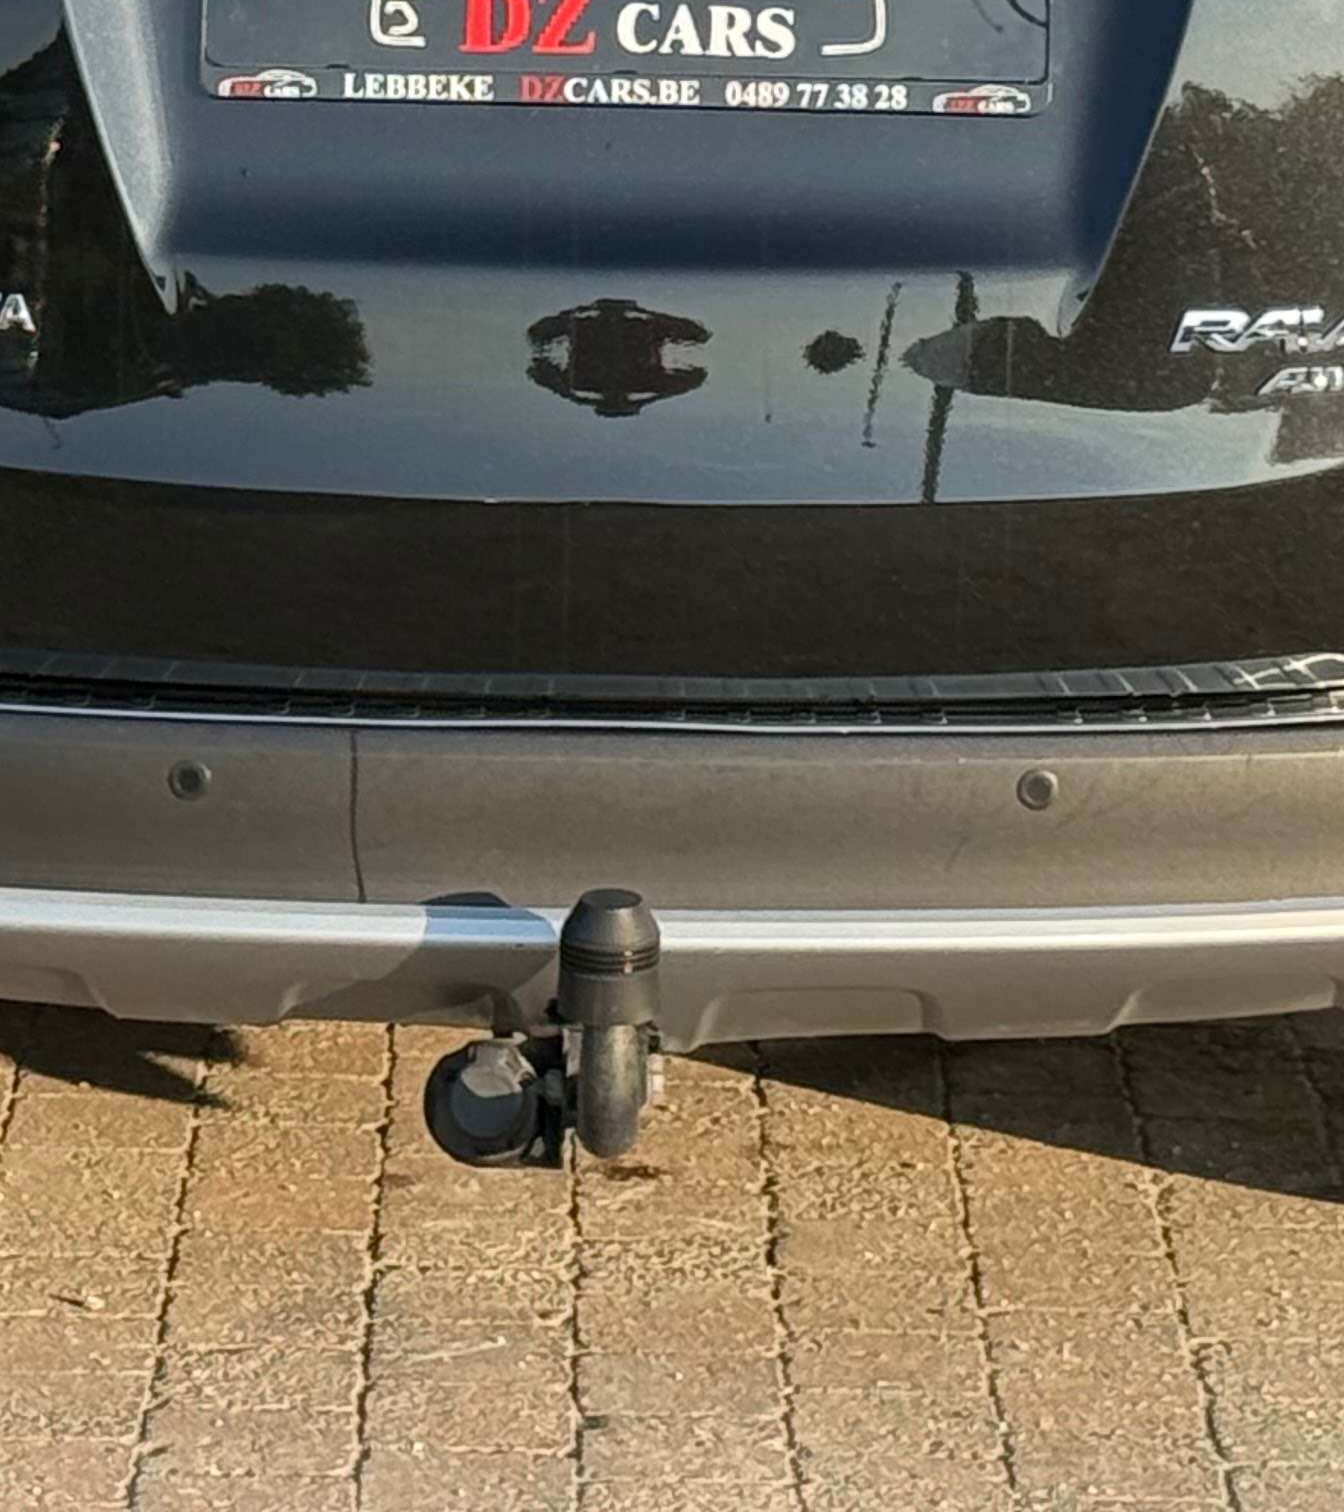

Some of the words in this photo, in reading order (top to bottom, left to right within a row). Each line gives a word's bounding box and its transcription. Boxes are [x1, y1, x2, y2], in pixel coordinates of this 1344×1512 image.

[616, 1, 796, 59] CARS
[343, 72, 495, 101] LEBBEKE
[518, 74, 701, 105] DZCARS.BE
[723, 81, 786, 108] 0489
[796, 83, 830, 109] 77
[833, 84, 869, 110] 38
[873, 85, 908, 111] 28
